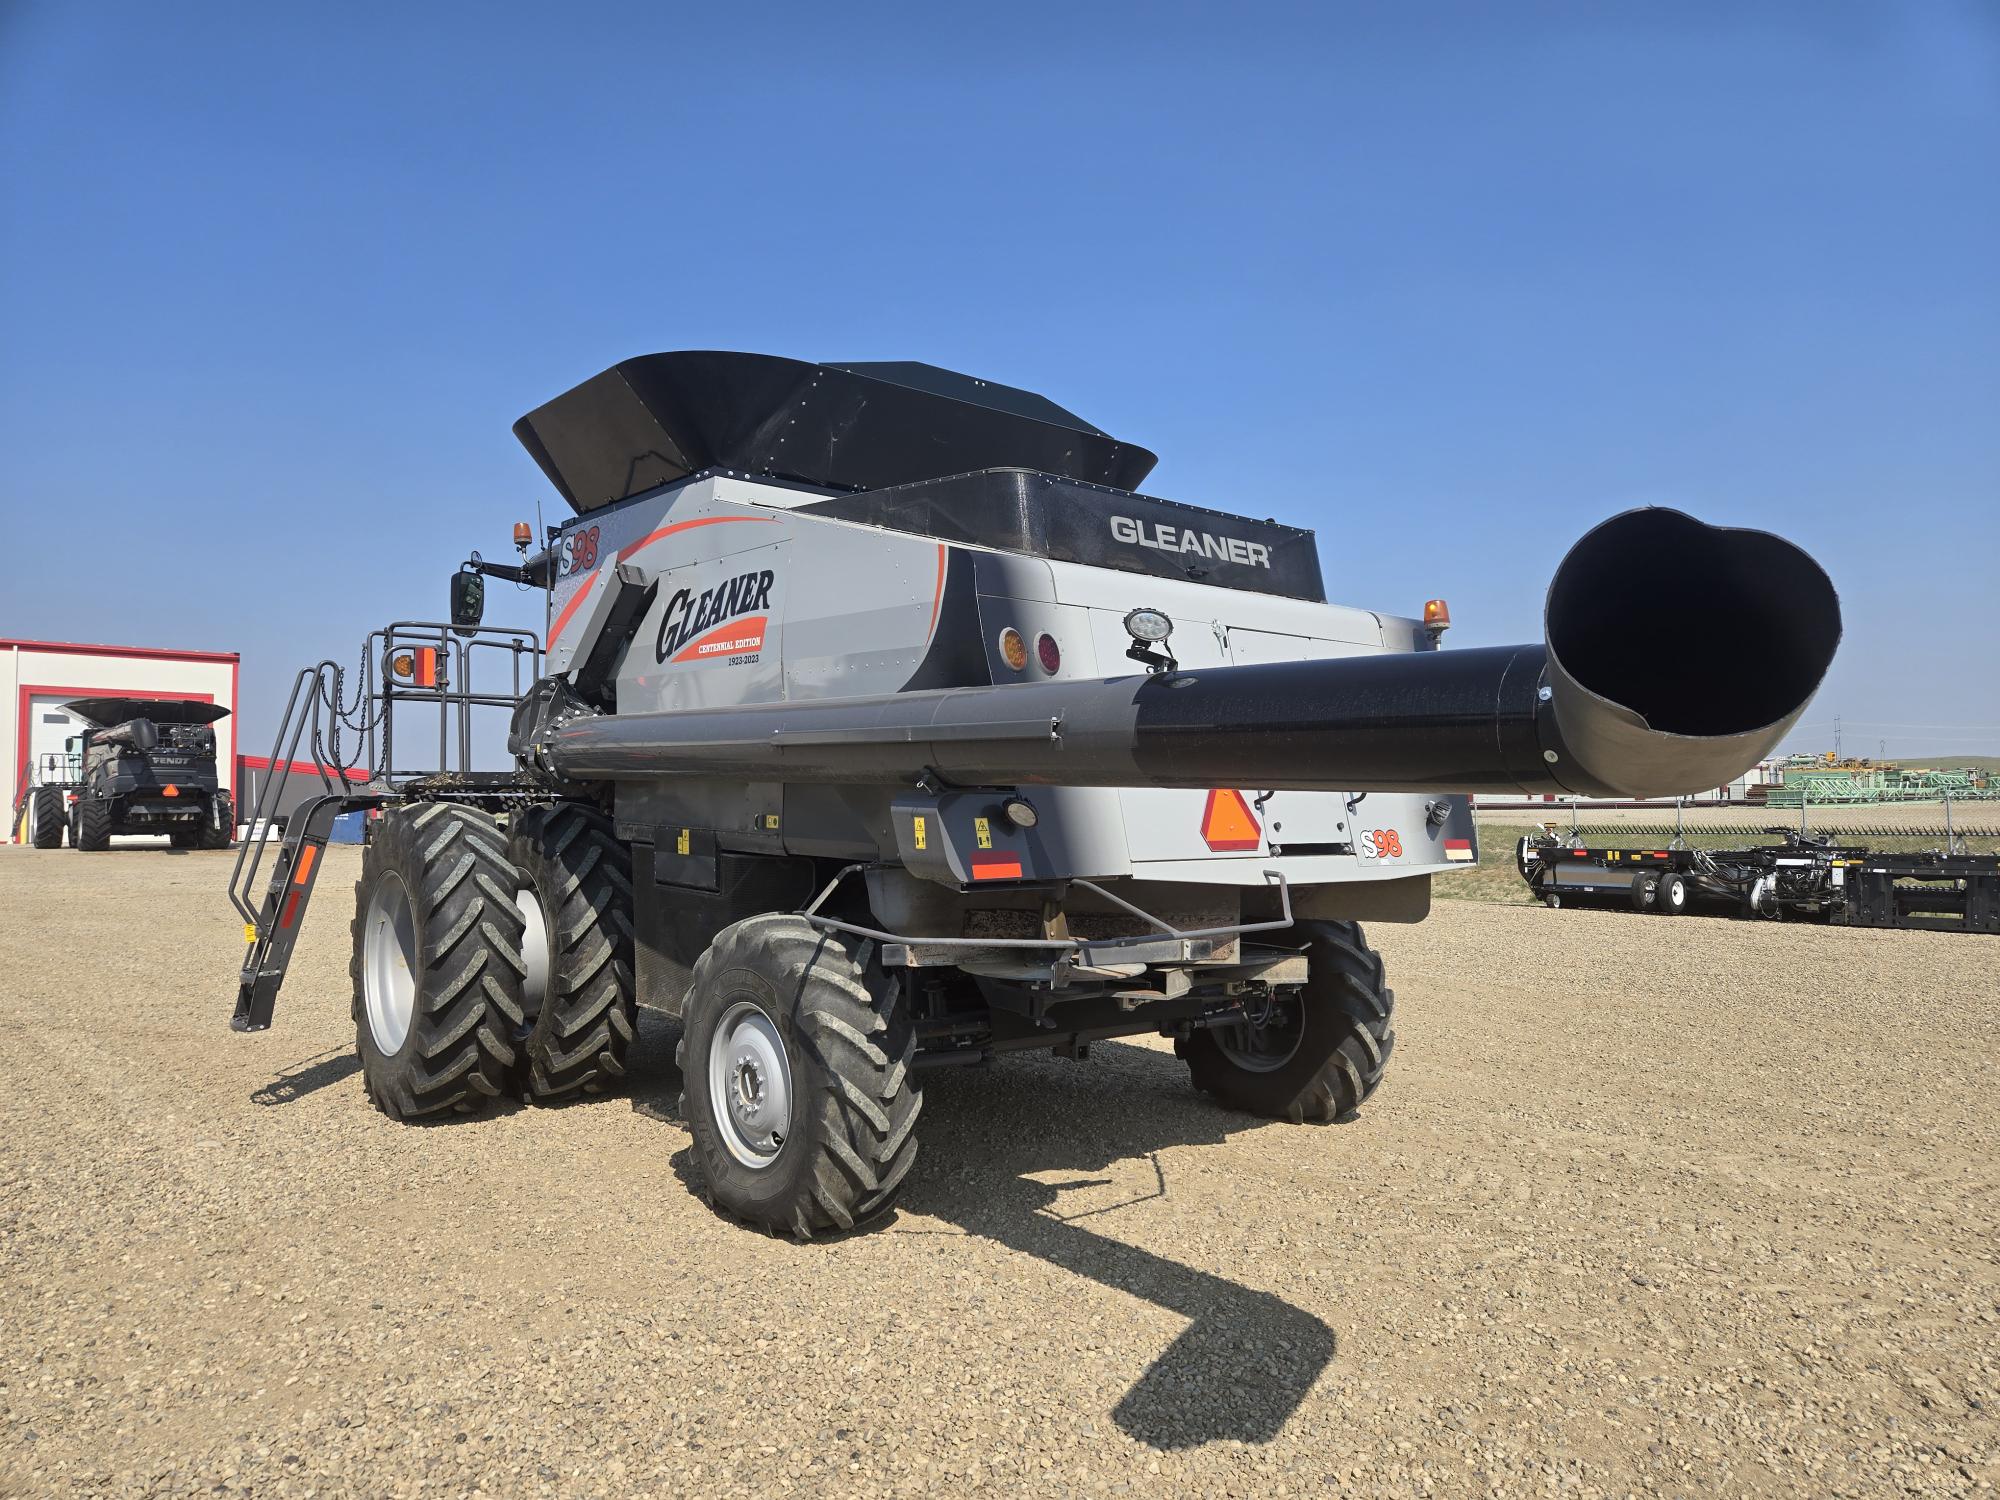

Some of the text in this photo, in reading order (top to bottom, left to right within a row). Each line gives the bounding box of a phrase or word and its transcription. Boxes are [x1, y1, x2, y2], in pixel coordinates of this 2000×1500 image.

[560, 526, 600, 577] S98
[656, 569, 774, 664] GLEANER
[698, 637, 761, 654] CENTENNIAL EDITION
[728, 654, 759, 666] 1923-2023
[1360, 829, 1403, 858] S98
